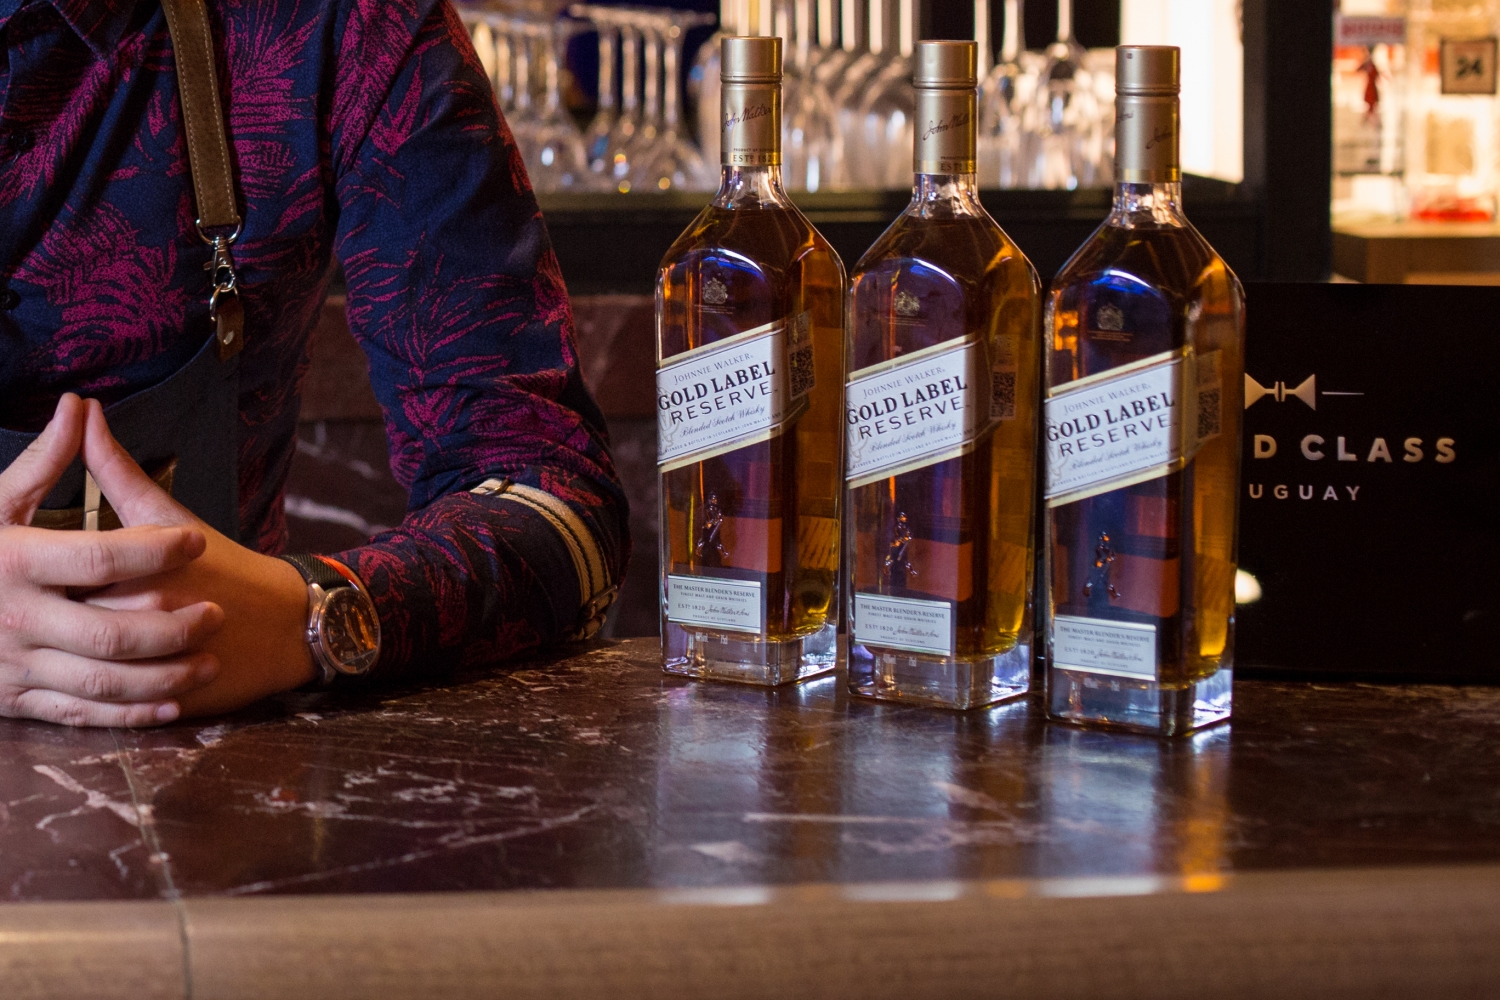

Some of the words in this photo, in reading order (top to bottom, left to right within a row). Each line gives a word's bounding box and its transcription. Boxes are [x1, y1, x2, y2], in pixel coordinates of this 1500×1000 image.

[658, 383, 708, 410] GOLD
[711, 361, 775, 393] LABEL
[674, 366, 712, 385] JOHNNIE
[714, 353, 750, 371] WALKER
[863, 380, 901, 400] JOHNNIE
[904, 367, 942, 384] WALKER
[671, 381, 773, 425] RESERVE
[847, 397, 898, 425] GOLD
[900, 375, 968, 408] LABEL
[1064, 396, 1105, 416] JOHNNIE
[1108, 383, 1147, 401] WALKER
[680, 422, 711, 437] Blended
[712, 414, 735, 427] Scotch
[737, 404, 765, 419] Whisky
[859, 396, 964, 440] RESERVE
[1047, 413, 1100, 442] GOLD
[1104, 392, 1175, 424] LABEL
[1059, 413, 1172, 457] RESERVE
[1254, 434, 1277, 459] D
[1300, 434, 1456, 463] CLASS
[1249, 484, 1360, 501] UGUAY
[923, 611, 945, 619] RESERVE
